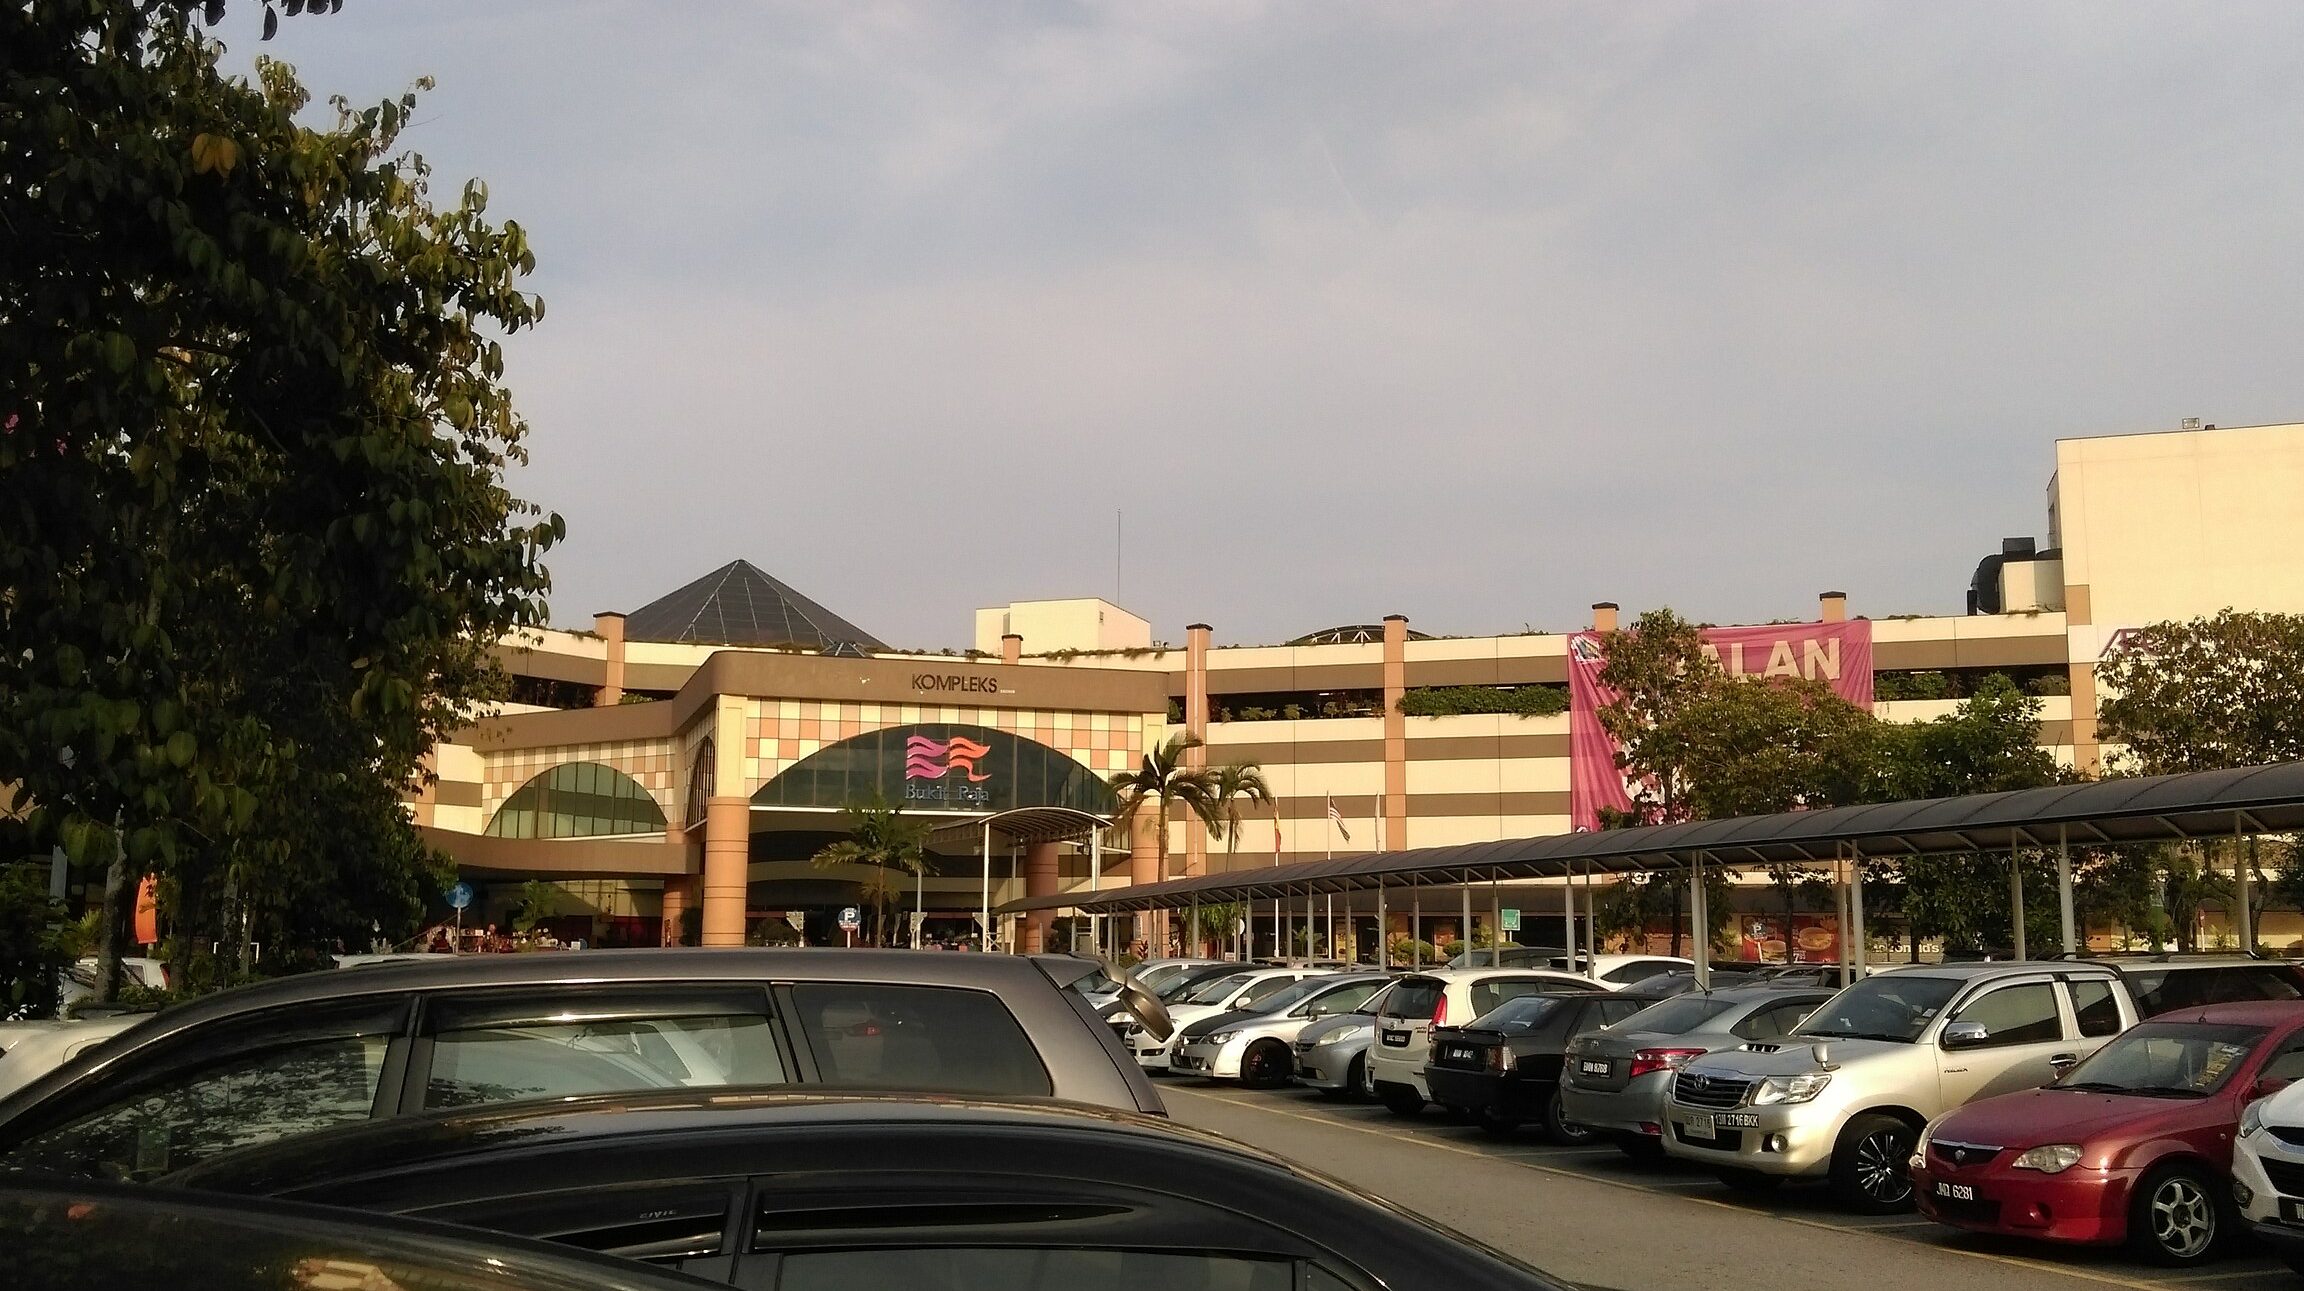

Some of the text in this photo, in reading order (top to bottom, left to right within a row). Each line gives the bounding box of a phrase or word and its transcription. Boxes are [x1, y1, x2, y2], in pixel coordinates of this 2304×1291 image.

[911, 673, 998, 694] KOMPLEKS
[905, 784, 990, 806] Bukit Raja
[1727, 1114, 1744, 1128] 2716
[1743, 1115, 1759, 1128] BKK
[1952, 1184, 1973, 1201] 6281
